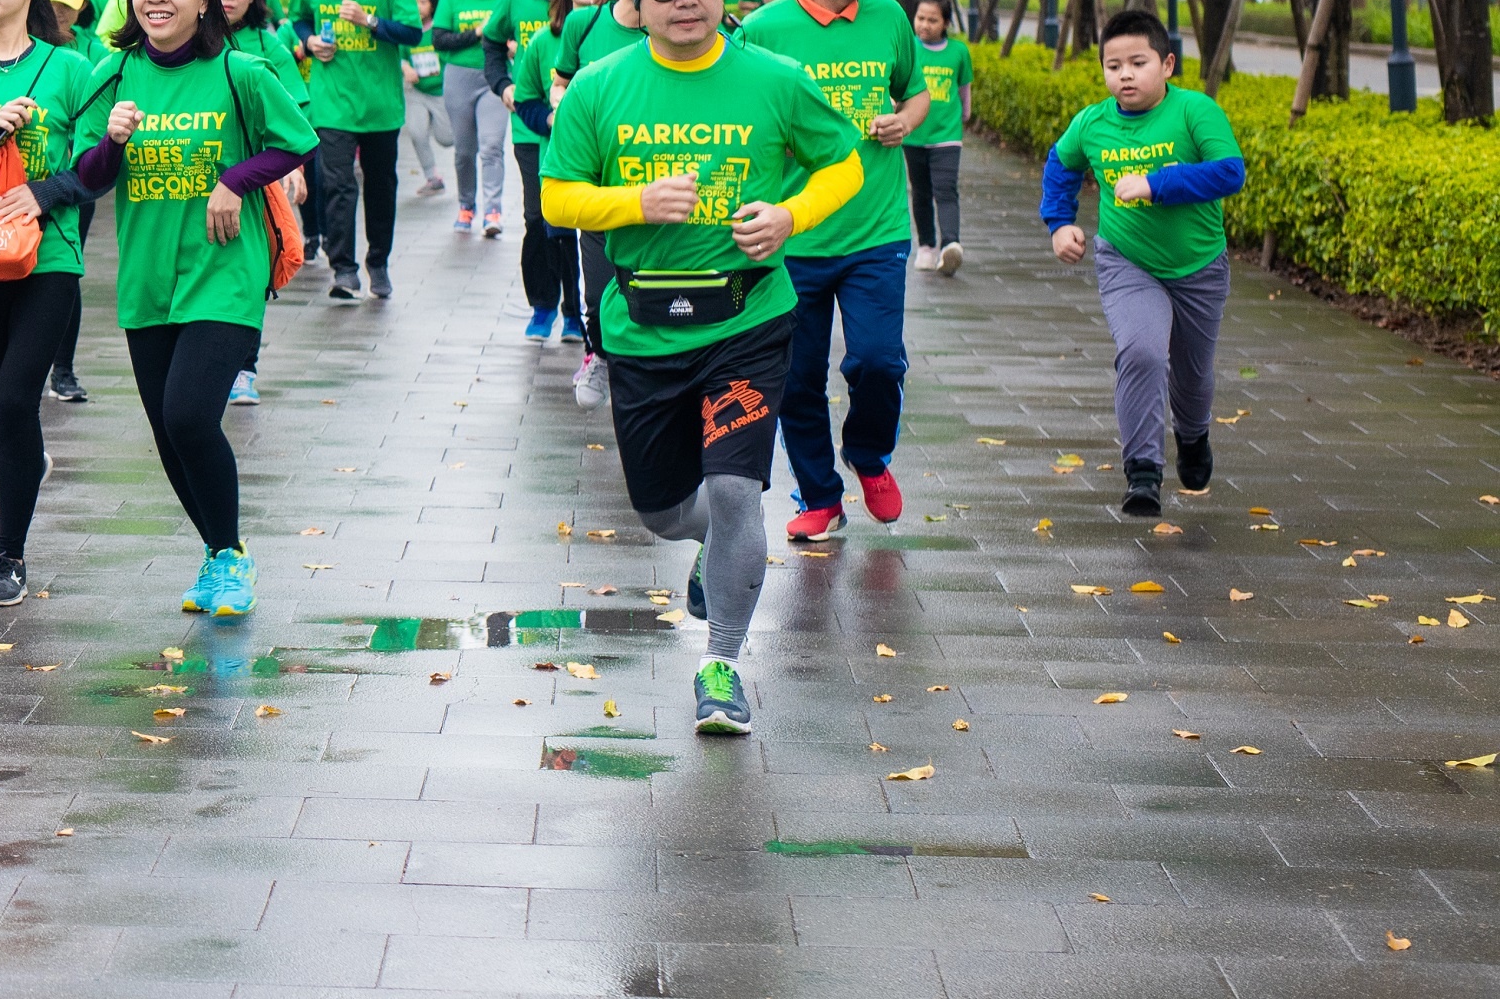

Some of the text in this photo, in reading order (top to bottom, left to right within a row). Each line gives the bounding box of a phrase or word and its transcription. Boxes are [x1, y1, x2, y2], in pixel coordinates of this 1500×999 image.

[804, 61, 887, 81] ARKCITY
[617, 123, 754, 146] PARKCITY
[126, 146, 183, 165] CIBES
[677, 152, 692, 162] CÓ
[1101, 141, 1175, 163] PARKCITY
[625, 161, 700, 182] CIBES
[720, 164, 735, 172] VIB
[131, 174, 208, 196] RICONS
[698, 189, 735, 198] COFICO
[685, 217, 719, 226] UCTON
[703, 405, 770, 448] UNDER ARMOUR
